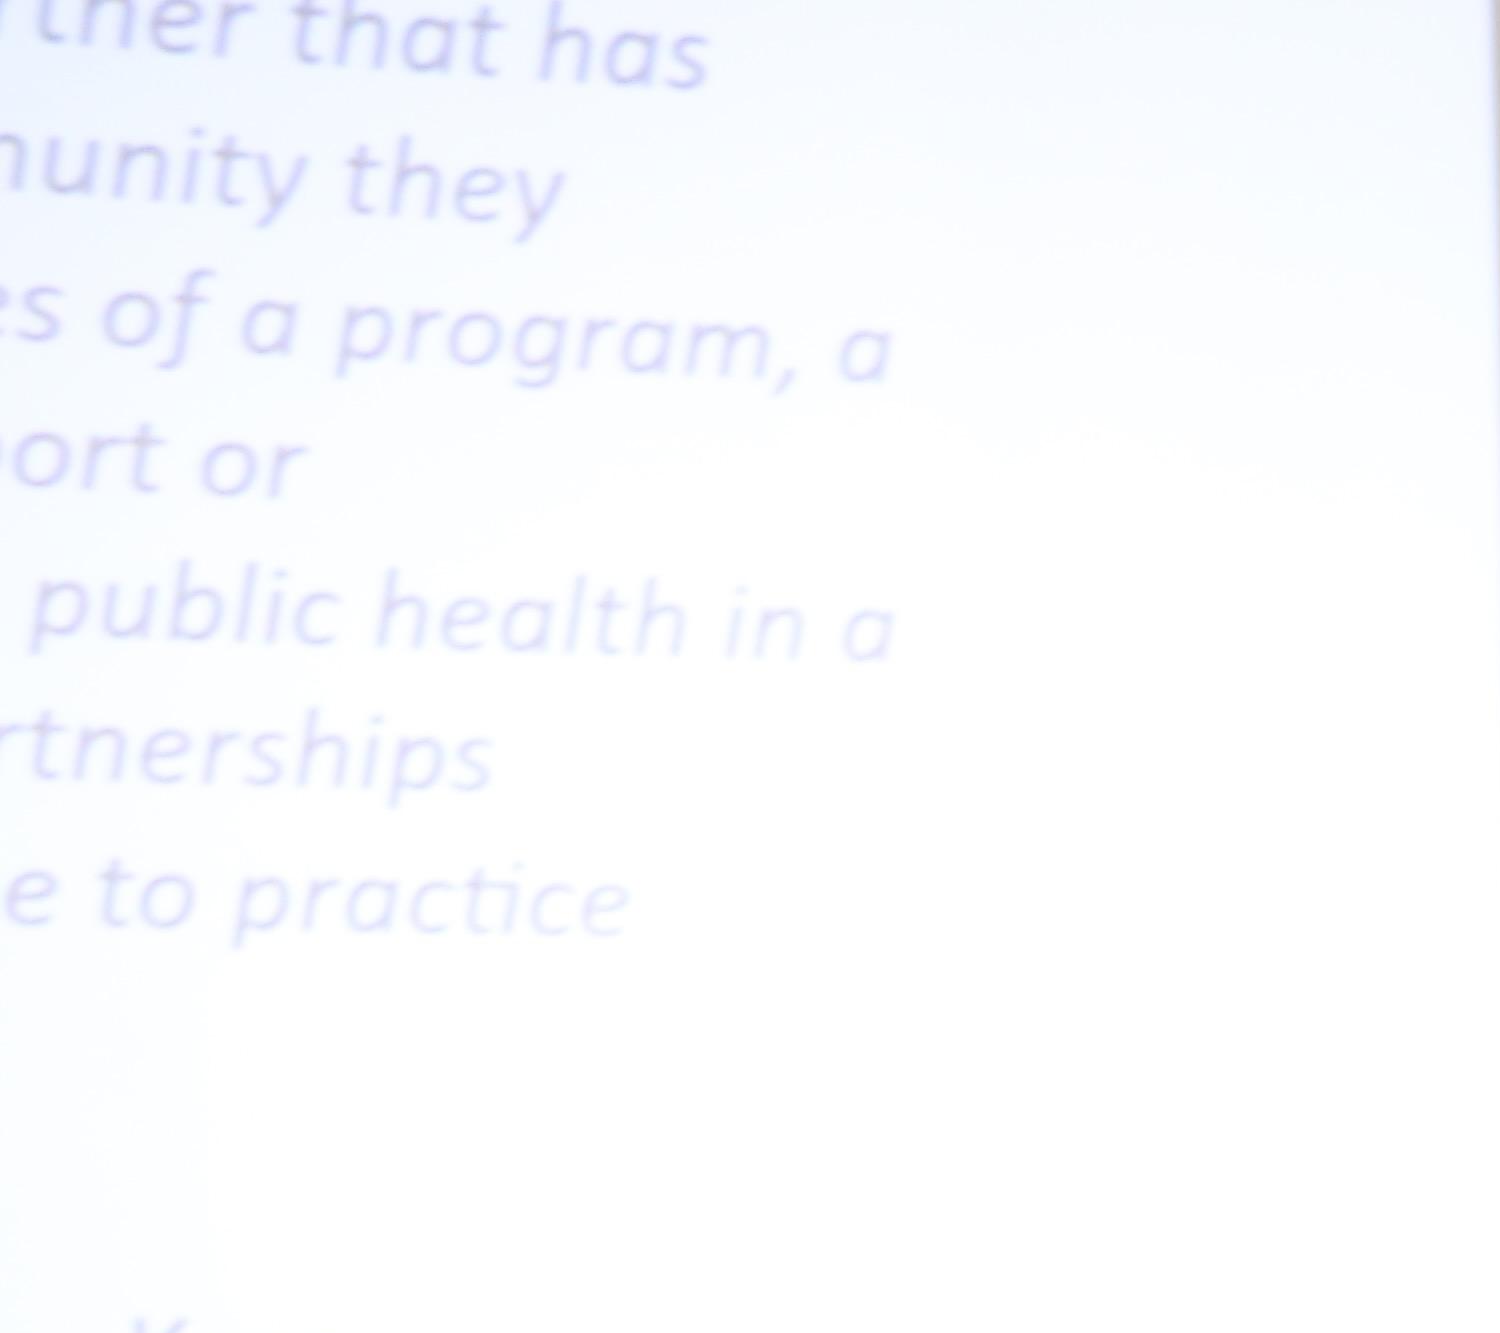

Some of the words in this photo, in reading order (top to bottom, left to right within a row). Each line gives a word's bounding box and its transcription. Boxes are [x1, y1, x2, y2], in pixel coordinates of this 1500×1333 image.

[290, 0, 511, 79] that
[535, 0, 714, 91] has
[345, 133, 569, 244] they
[102, 268, 216, 371] of
[241, 296, 300, 360] a
[333, 302, 798, 396] program,
[837, 327, 894, 384] a
[200, 437, 311, 501] or
[26, 557, 344, 655] public
[376, 565, 689, 657] health
[722, 584, 806, 663] in
[841, 602, 898, 667] a
[97, 856, 196, 931] to
[229, 860, 633, 949] practice
